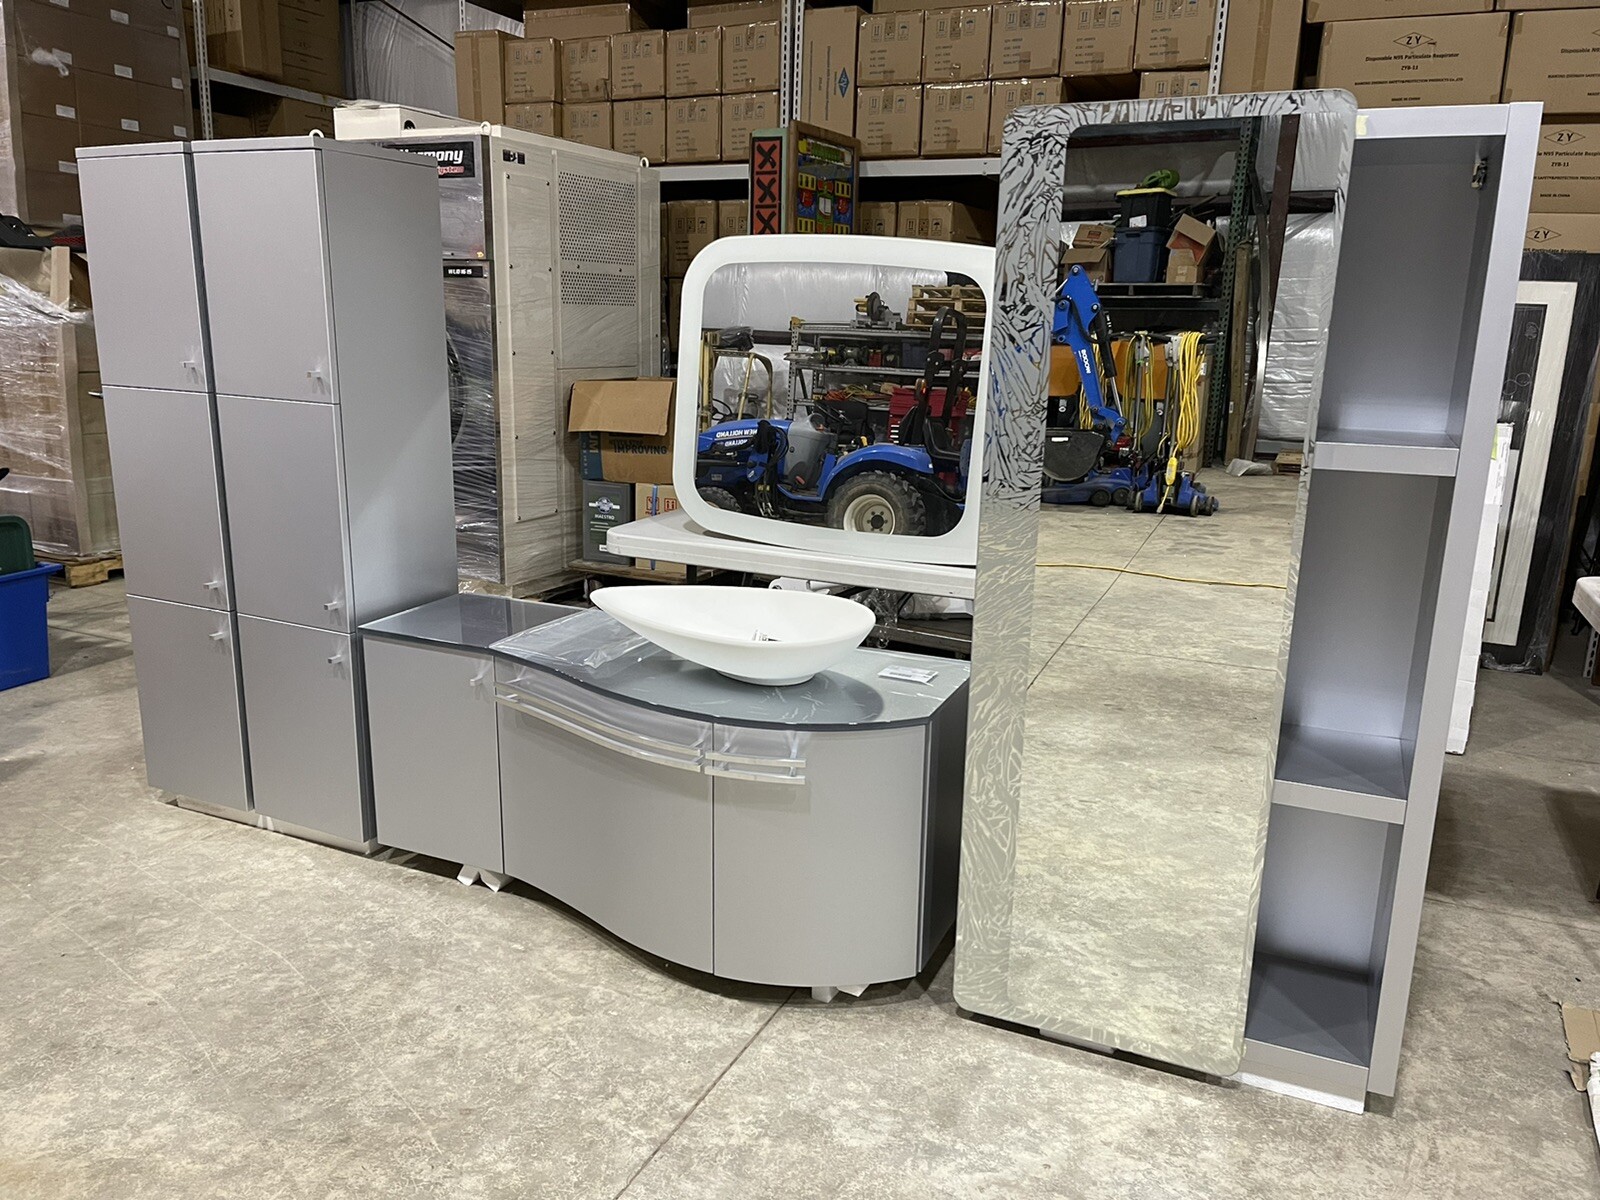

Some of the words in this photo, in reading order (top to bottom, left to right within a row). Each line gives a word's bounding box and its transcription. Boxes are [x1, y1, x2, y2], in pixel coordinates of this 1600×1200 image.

[1557, 133, 1574, 142] ZY
[1534, 230, 1550, 239] ZY
[614, 443, 668, 454] IMPROVING
